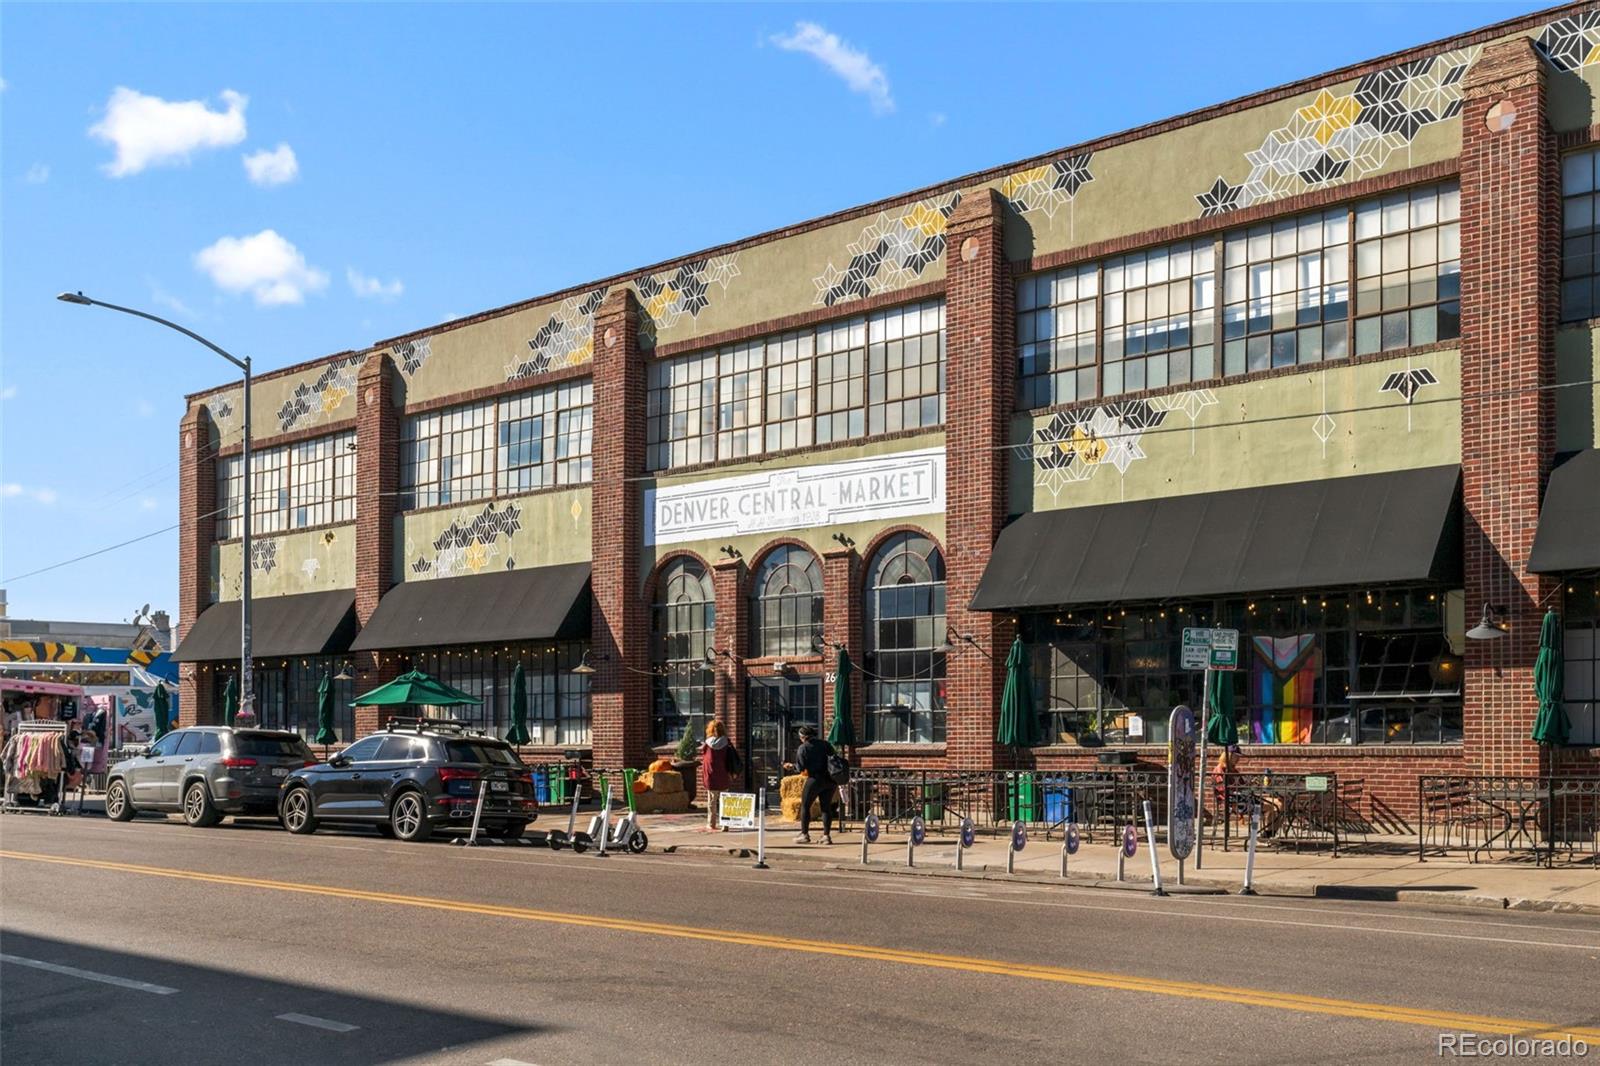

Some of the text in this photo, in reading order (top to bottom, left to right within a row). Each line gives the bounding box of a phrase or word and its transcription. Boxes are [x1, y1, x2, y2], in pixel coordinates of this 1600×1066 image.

[661, 496, 729, 527] DENVER
[738, 484, 827, 516] CENTRAL
[839, 469, 926, 505] MARKET
